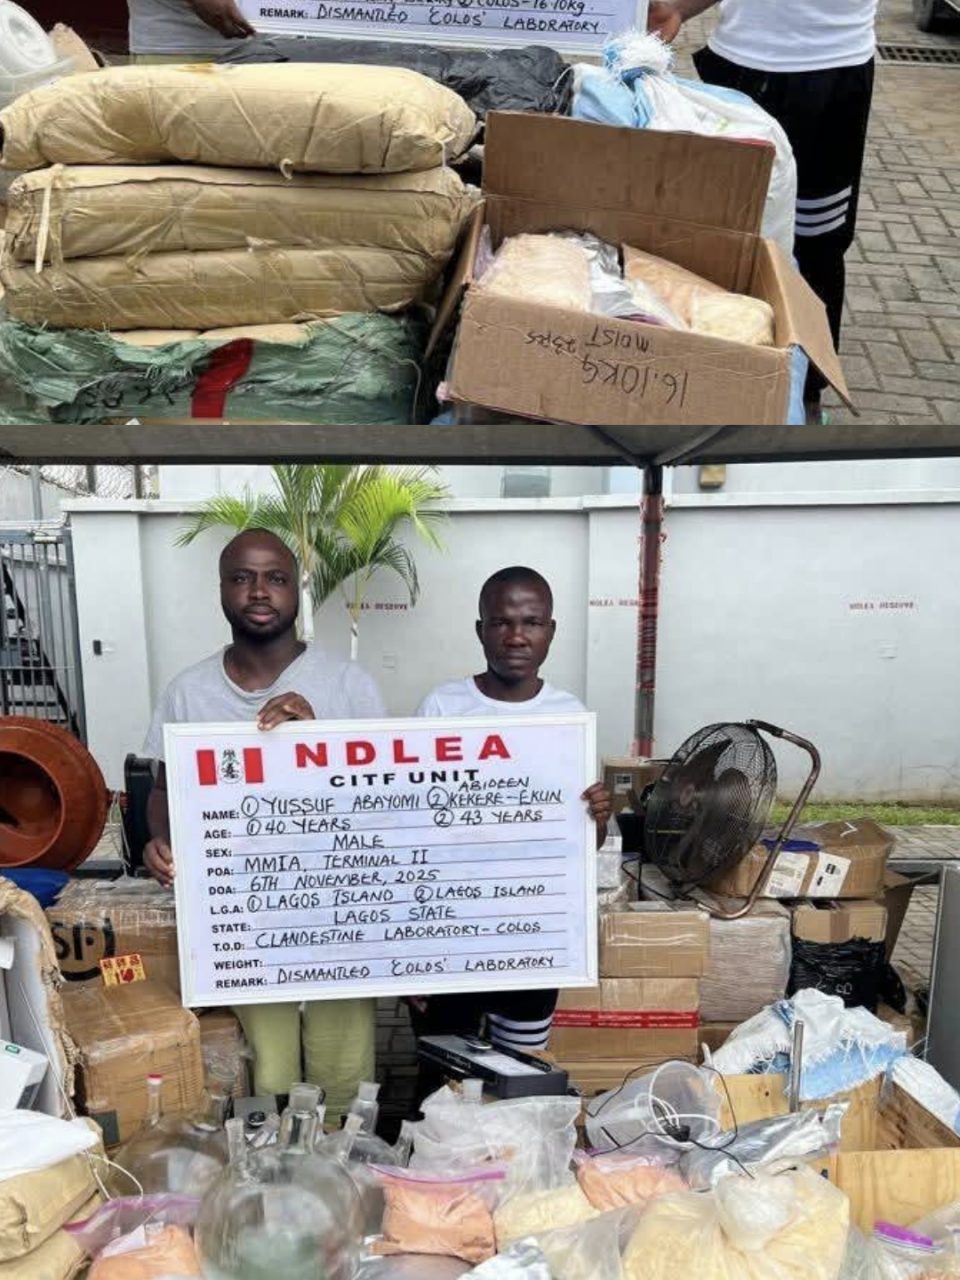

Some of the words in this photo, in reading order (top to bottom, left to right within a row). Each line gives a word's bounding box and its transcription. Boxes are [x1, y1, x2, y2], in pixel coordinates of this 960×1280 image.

[260, 8, 308, 19] REMARK:
[503, 16, 601, 33] LABORATORY
[295, 735, 511, 768] NDLEA
[329, 773, 396, 788] CITF
[409, 769, 479, 784] UNIT
[202, 810, 240, 821] NAME:
[204, 829, 232, 839] AGE:
[292, 818, 351, 834] YEARS
[460, 810, 483, 826] 43
[491, 809, 543, 824] YEARS
[205, 848, 233, 858] SEX:
[332, 834, 385, 852] MALE
[207, 867, 235, 877] POA:
[324, 854, 401, 870] TERMINAL
[209, 886, 237, 896] DOA:
[250, 875, 279, 892] 6TH
[395, 869, 440, 884] 2025
[332, 888, 394, 907] ISLAND
[493, 884, 546, 898] ISLAND
[211, 923, 251, 934] STATE:
[333, 909, 391, 925] LAGOS
[409, 905, 457, 921] STATE
[255, 929, 365, 949] CLANDESTINE
[214, 959, 264, 971] WEIGHT:
[216, 978, 268, 989] REMARK:
[465, 956, 555, 972] LABORATORY
